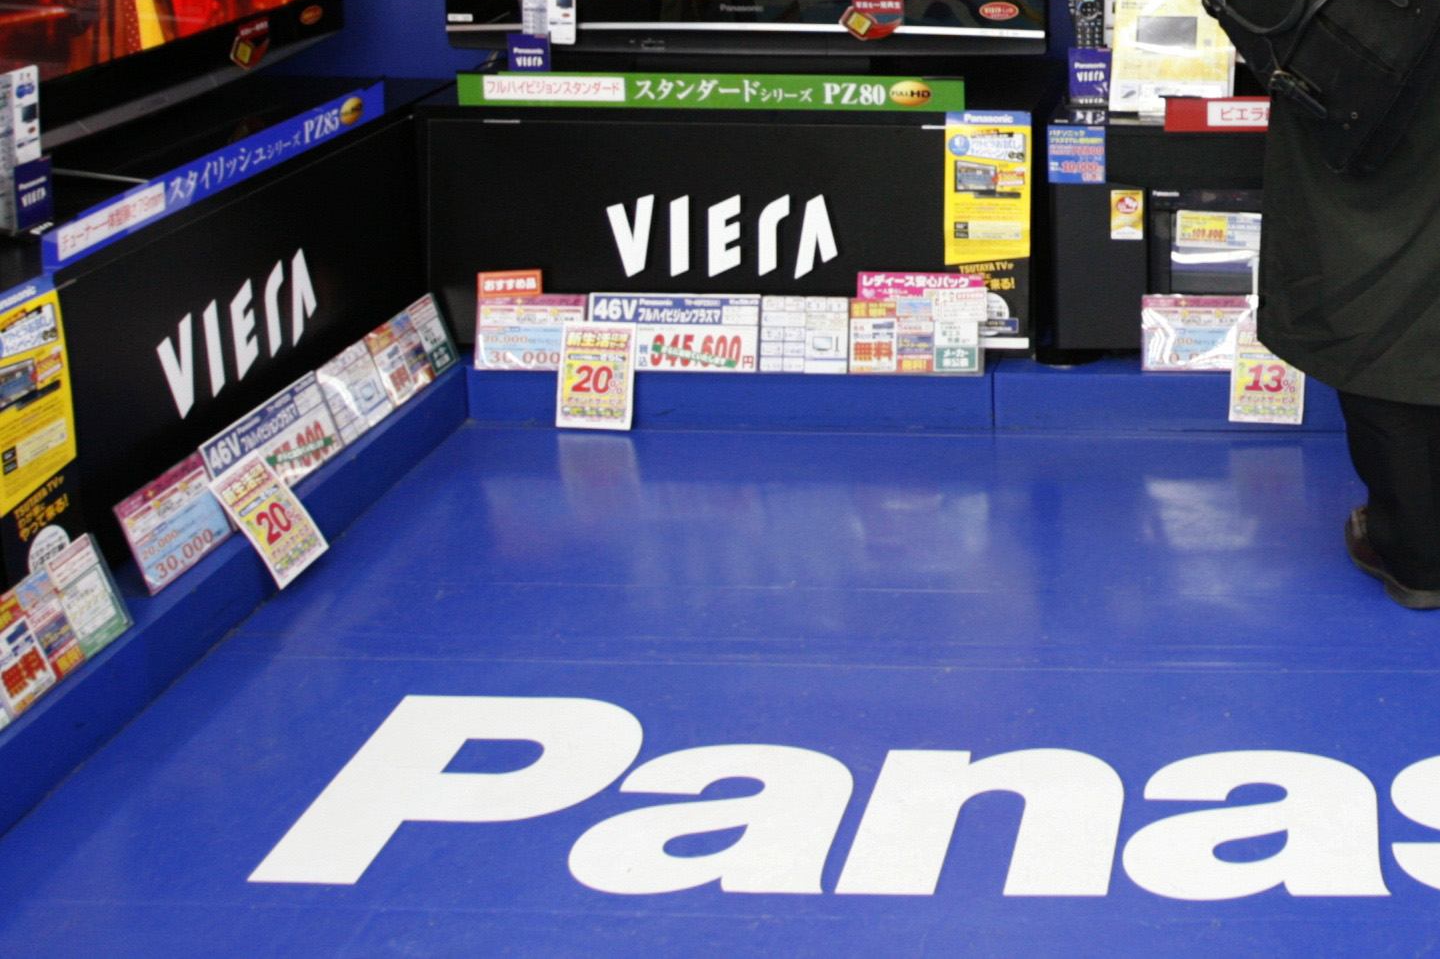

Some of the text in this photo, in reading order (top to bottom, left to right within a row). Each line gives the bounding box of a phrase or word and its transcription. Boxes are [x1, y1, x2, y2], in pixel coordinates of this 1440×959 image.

[485, 80, 621, 96] フルハイビジョンスタンダード
[634, 78, 887, 107] スタンダードシリーズ PZ80
[909, 87, 931, 99] HD
[963, 113, 1014, 124] Panasonic
[167, 111, 341, 205] スタイリッシュシリーズ PZ85
[604, 193, 839, 279] VIERA
[483, 276, 538, 292] おすすめ品
[862, 273, 971, 291] レディース安心パック
[593, 298, 638, 321] 46V
[637, 306, 722, 323] フルハイビジョンプラズマ
[156, 247, 318, 421] VIERA
[570, 364, 614, 394] 20
[1244, 364, 1286, 393] 13
[208, 433, 243, 472] 46V
[256, 501, 292, 545] 20
[155, 527, 214, 582] 30,000
